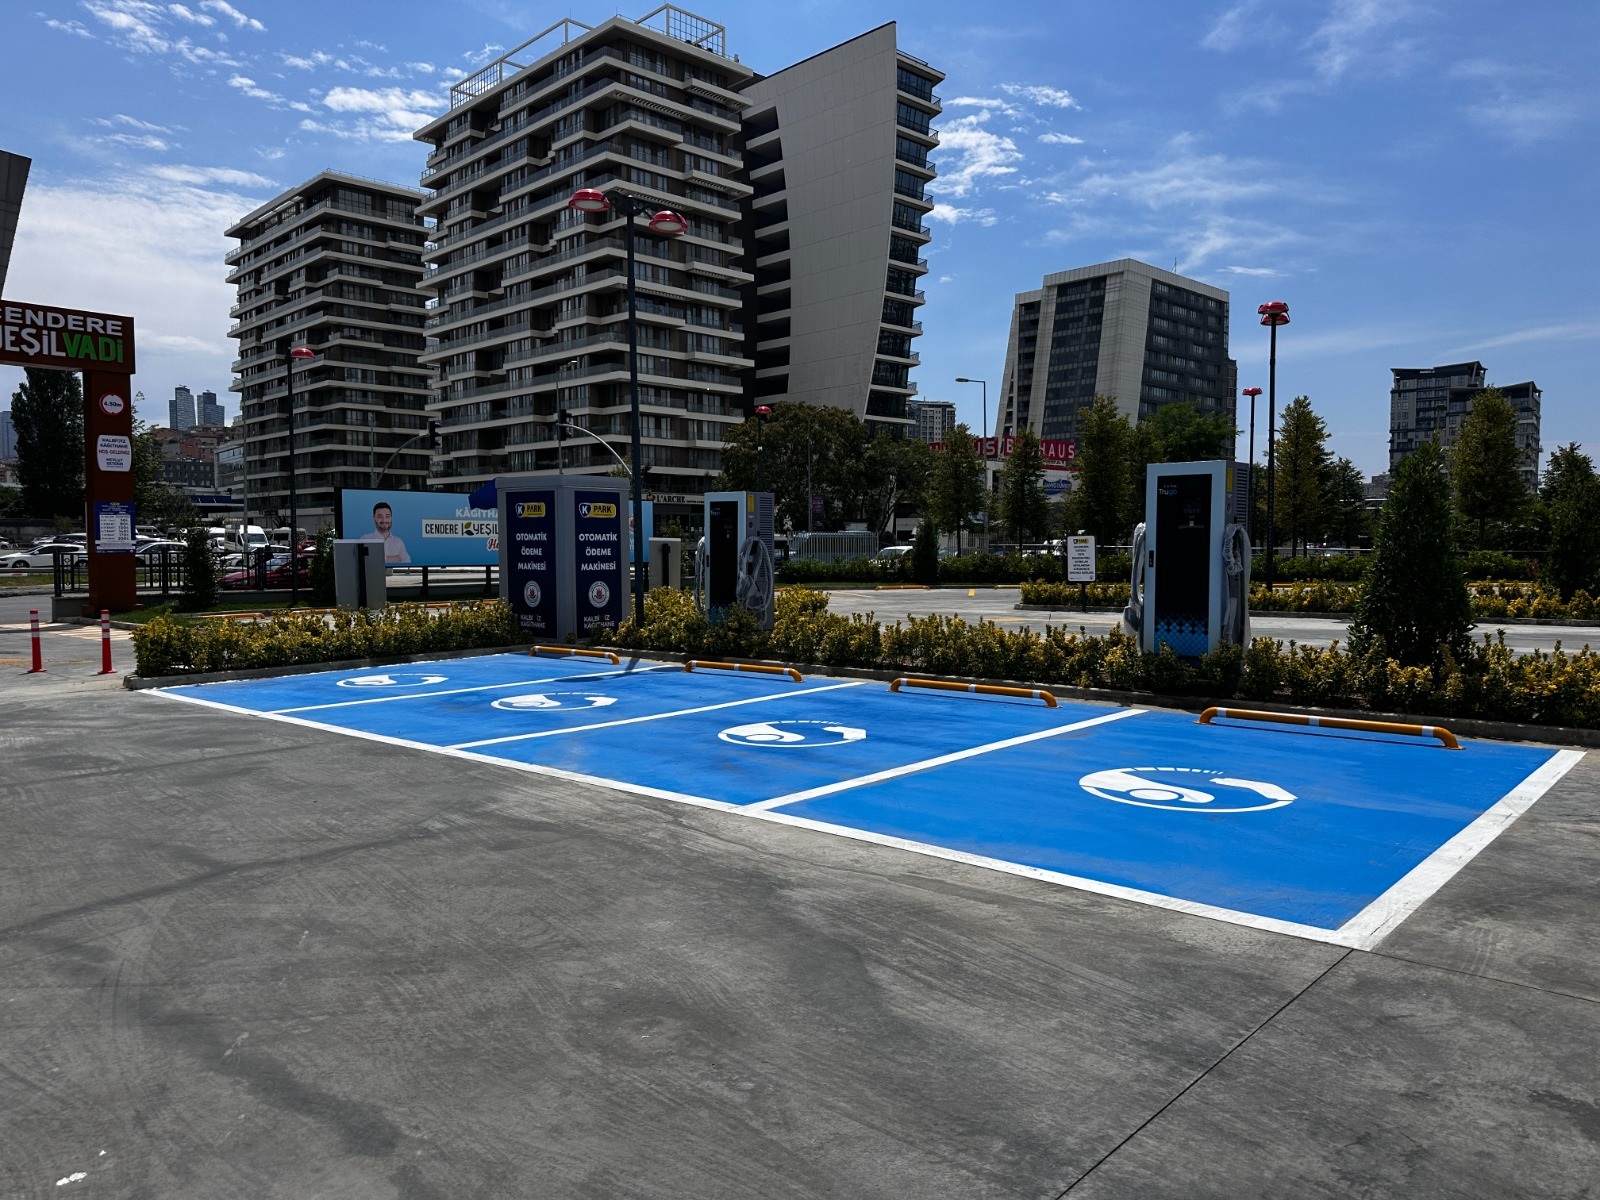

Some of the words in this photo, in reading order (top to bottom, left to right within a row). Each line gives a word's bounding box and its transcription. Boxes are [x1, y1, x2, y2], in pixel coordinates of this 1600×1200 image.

[0, 306, 123, 336] ENDERE
[1006, 438, 1076, 460] BHAUS
[526, 504, 542, 512] PARK
[593, 505, 612, 513] PARK
[424, 523, 459, 535] CENDERE
[516, 531, 548, 541] OTOMATİK
[578, 531, 618, 542] OTOMATİK
[520, 547, 543, 556] ÖDEME
[585, 547, 612, 556] ÖDEME
[517, 561, 547, 571] MAKİNESİ
[581, 561, 616, 571] MAKİNESİ
